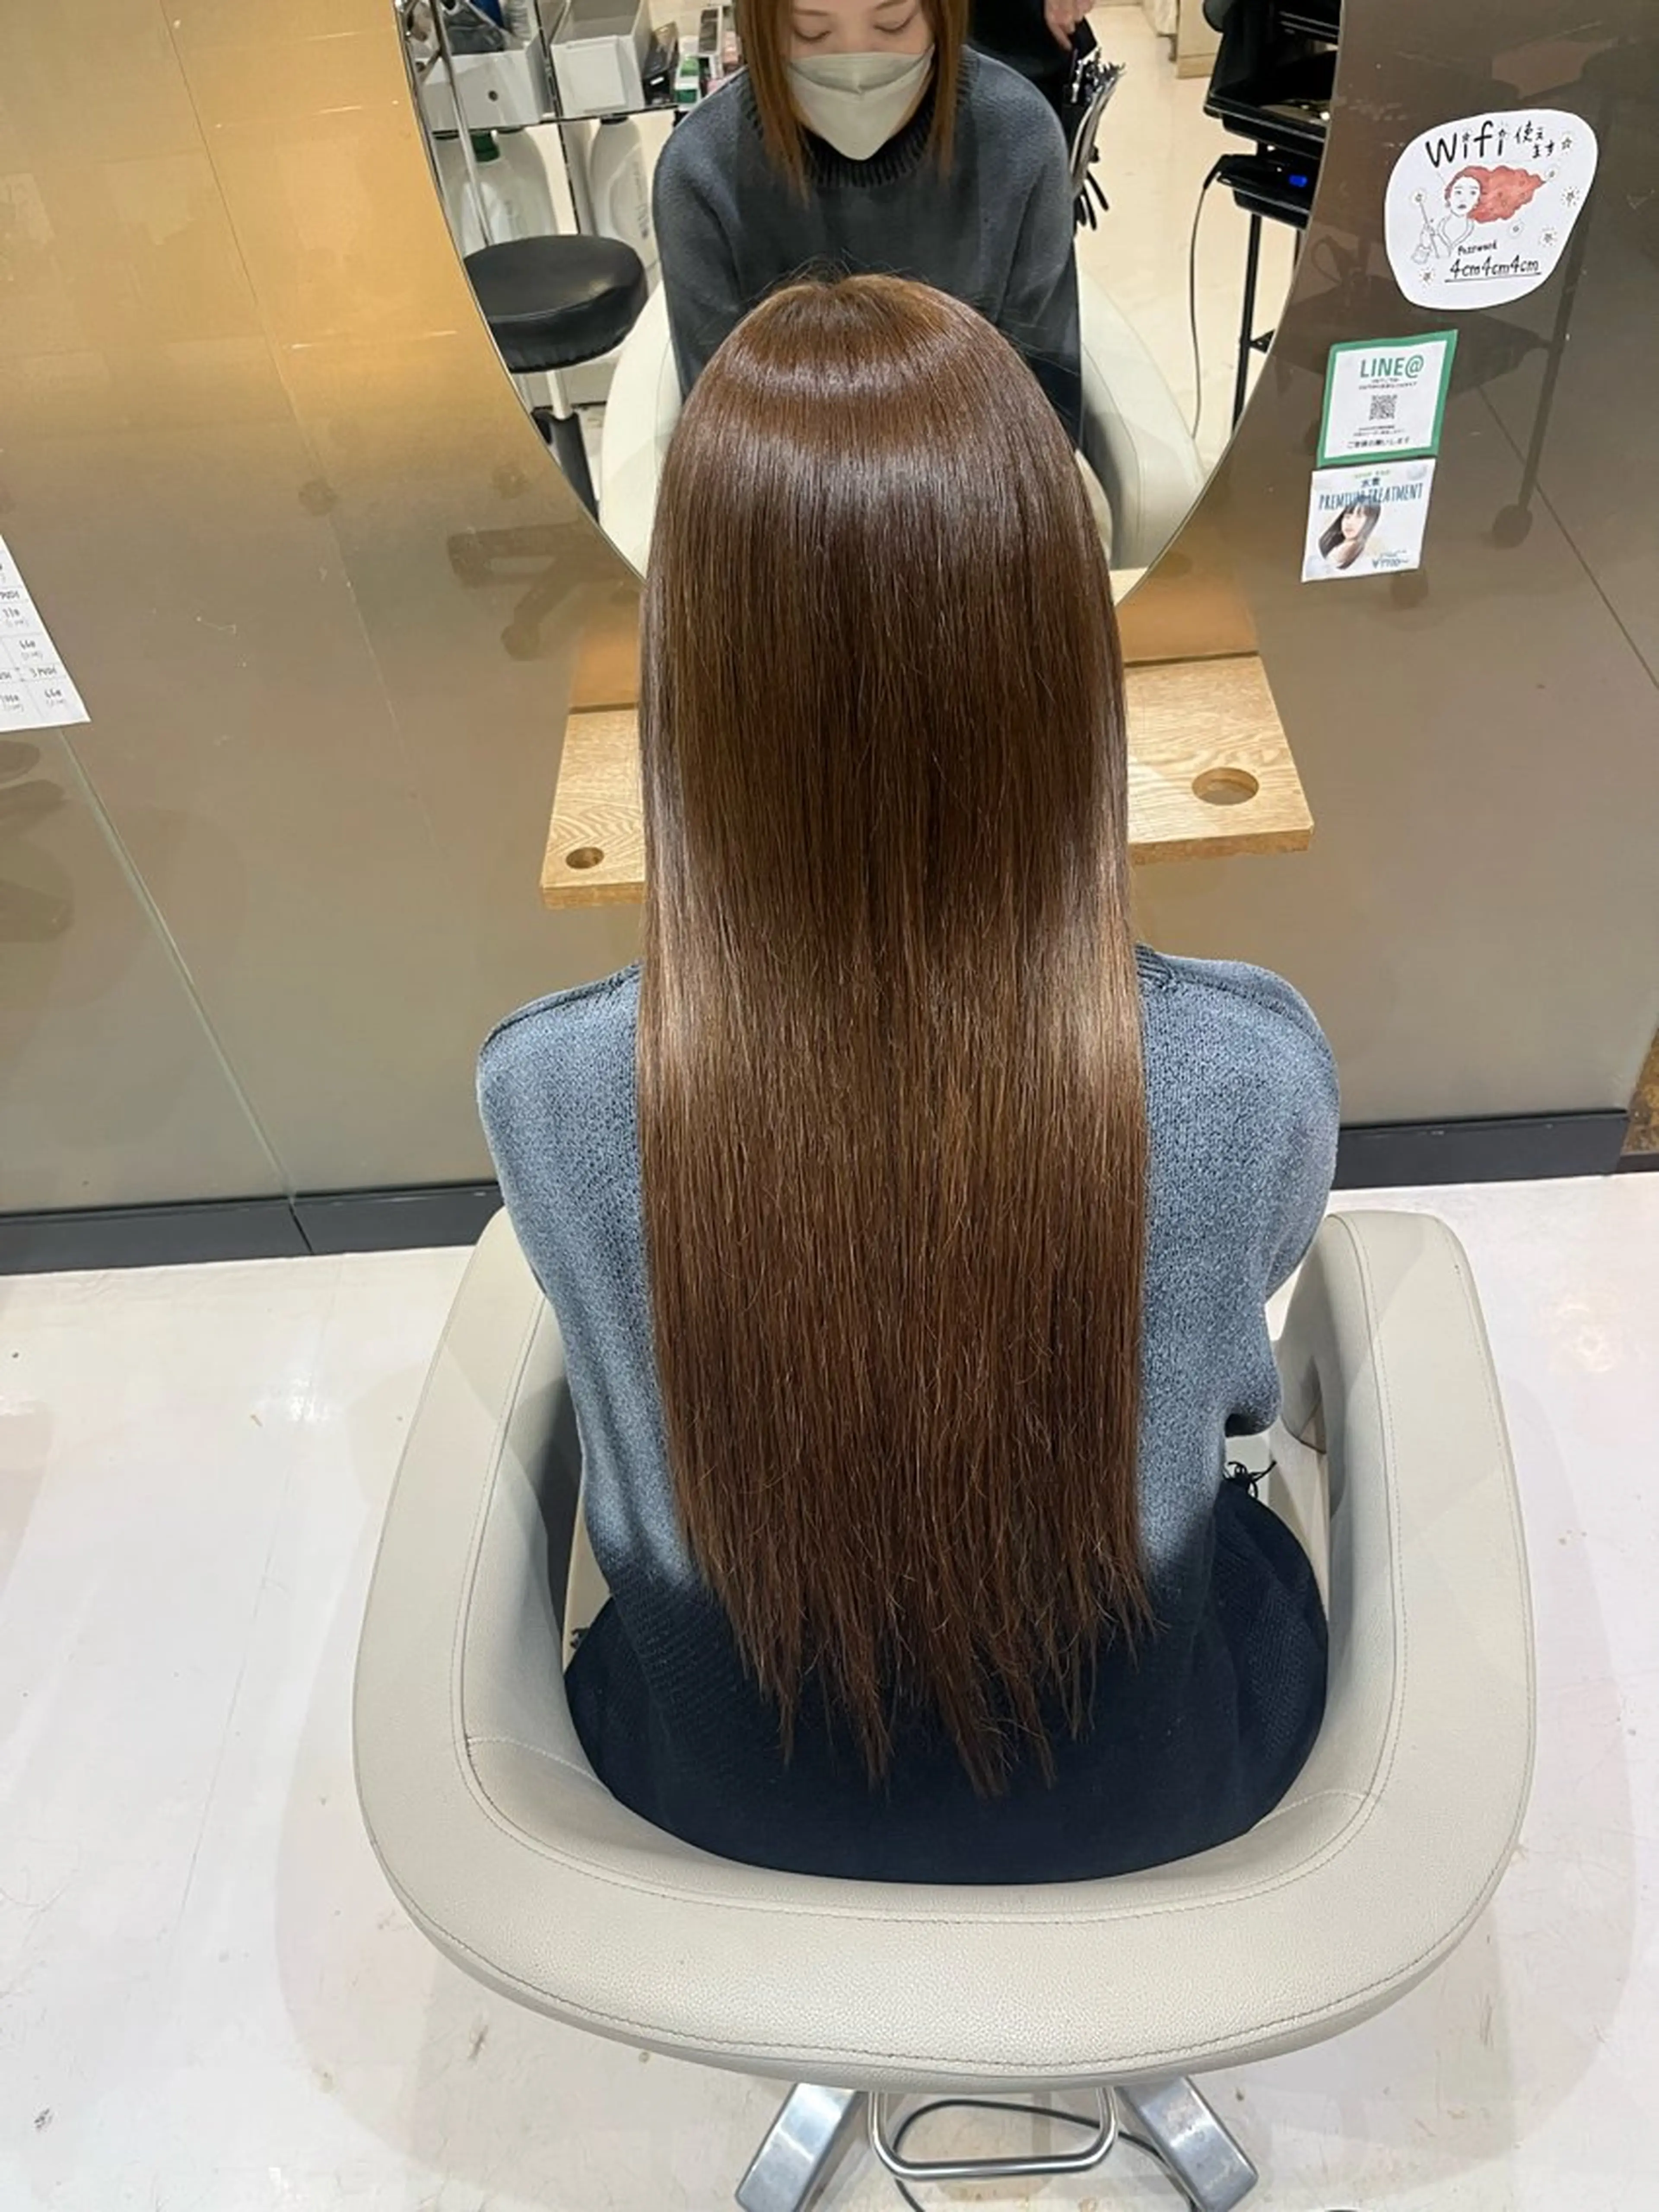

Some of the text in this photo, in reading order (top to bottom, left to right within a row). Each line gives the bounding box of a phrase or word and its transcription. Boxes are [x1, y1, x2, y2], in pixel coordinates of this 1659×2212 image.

[1426, 121, 1507, 168] Wifi
[1360, 354, 1424, 378] LINE@
[1368, 482, 1424, 505] TREATMENT
